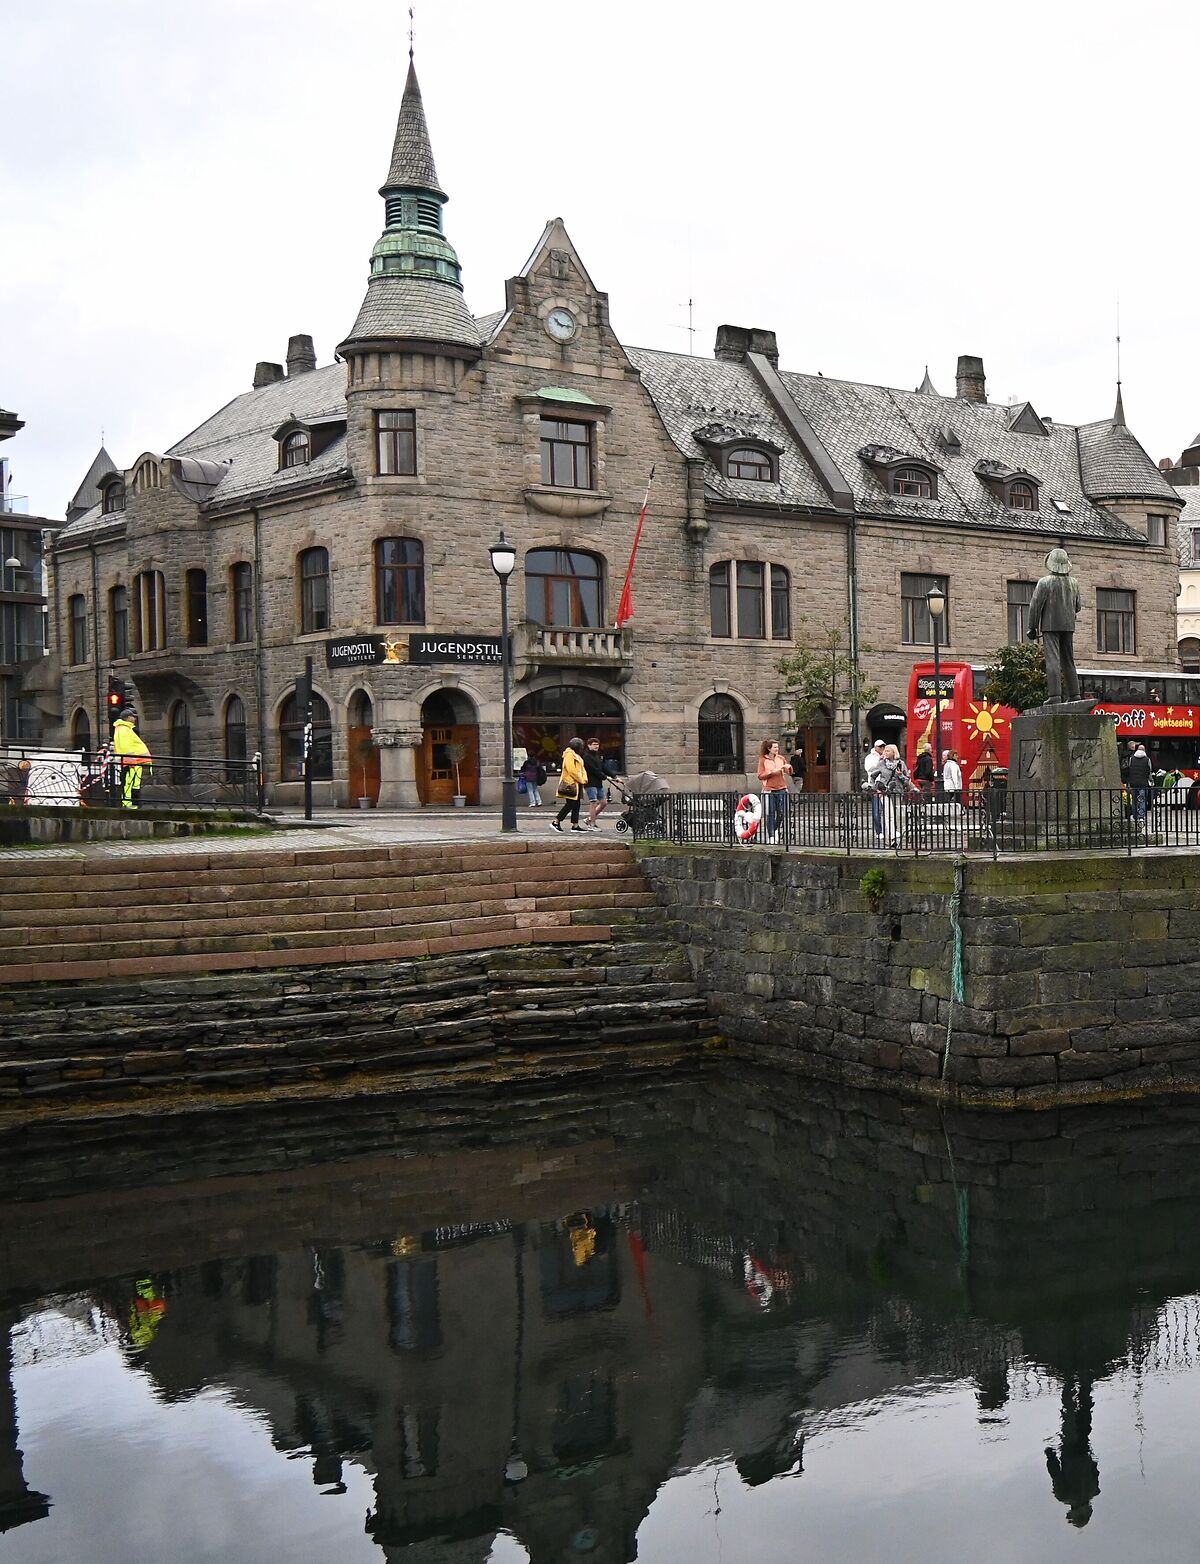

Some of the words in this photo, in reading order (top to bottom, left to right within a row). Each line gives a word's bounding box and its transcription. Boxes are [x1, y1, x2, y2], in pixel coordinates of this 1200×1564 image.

[332, 643, 375, 657] JUGENDSTIL
[420, 642, 502, 655] JUGENDSTIL
[1121, 709, 1145, 728] off
[1153, 717, 1193, 729] sightseeing
